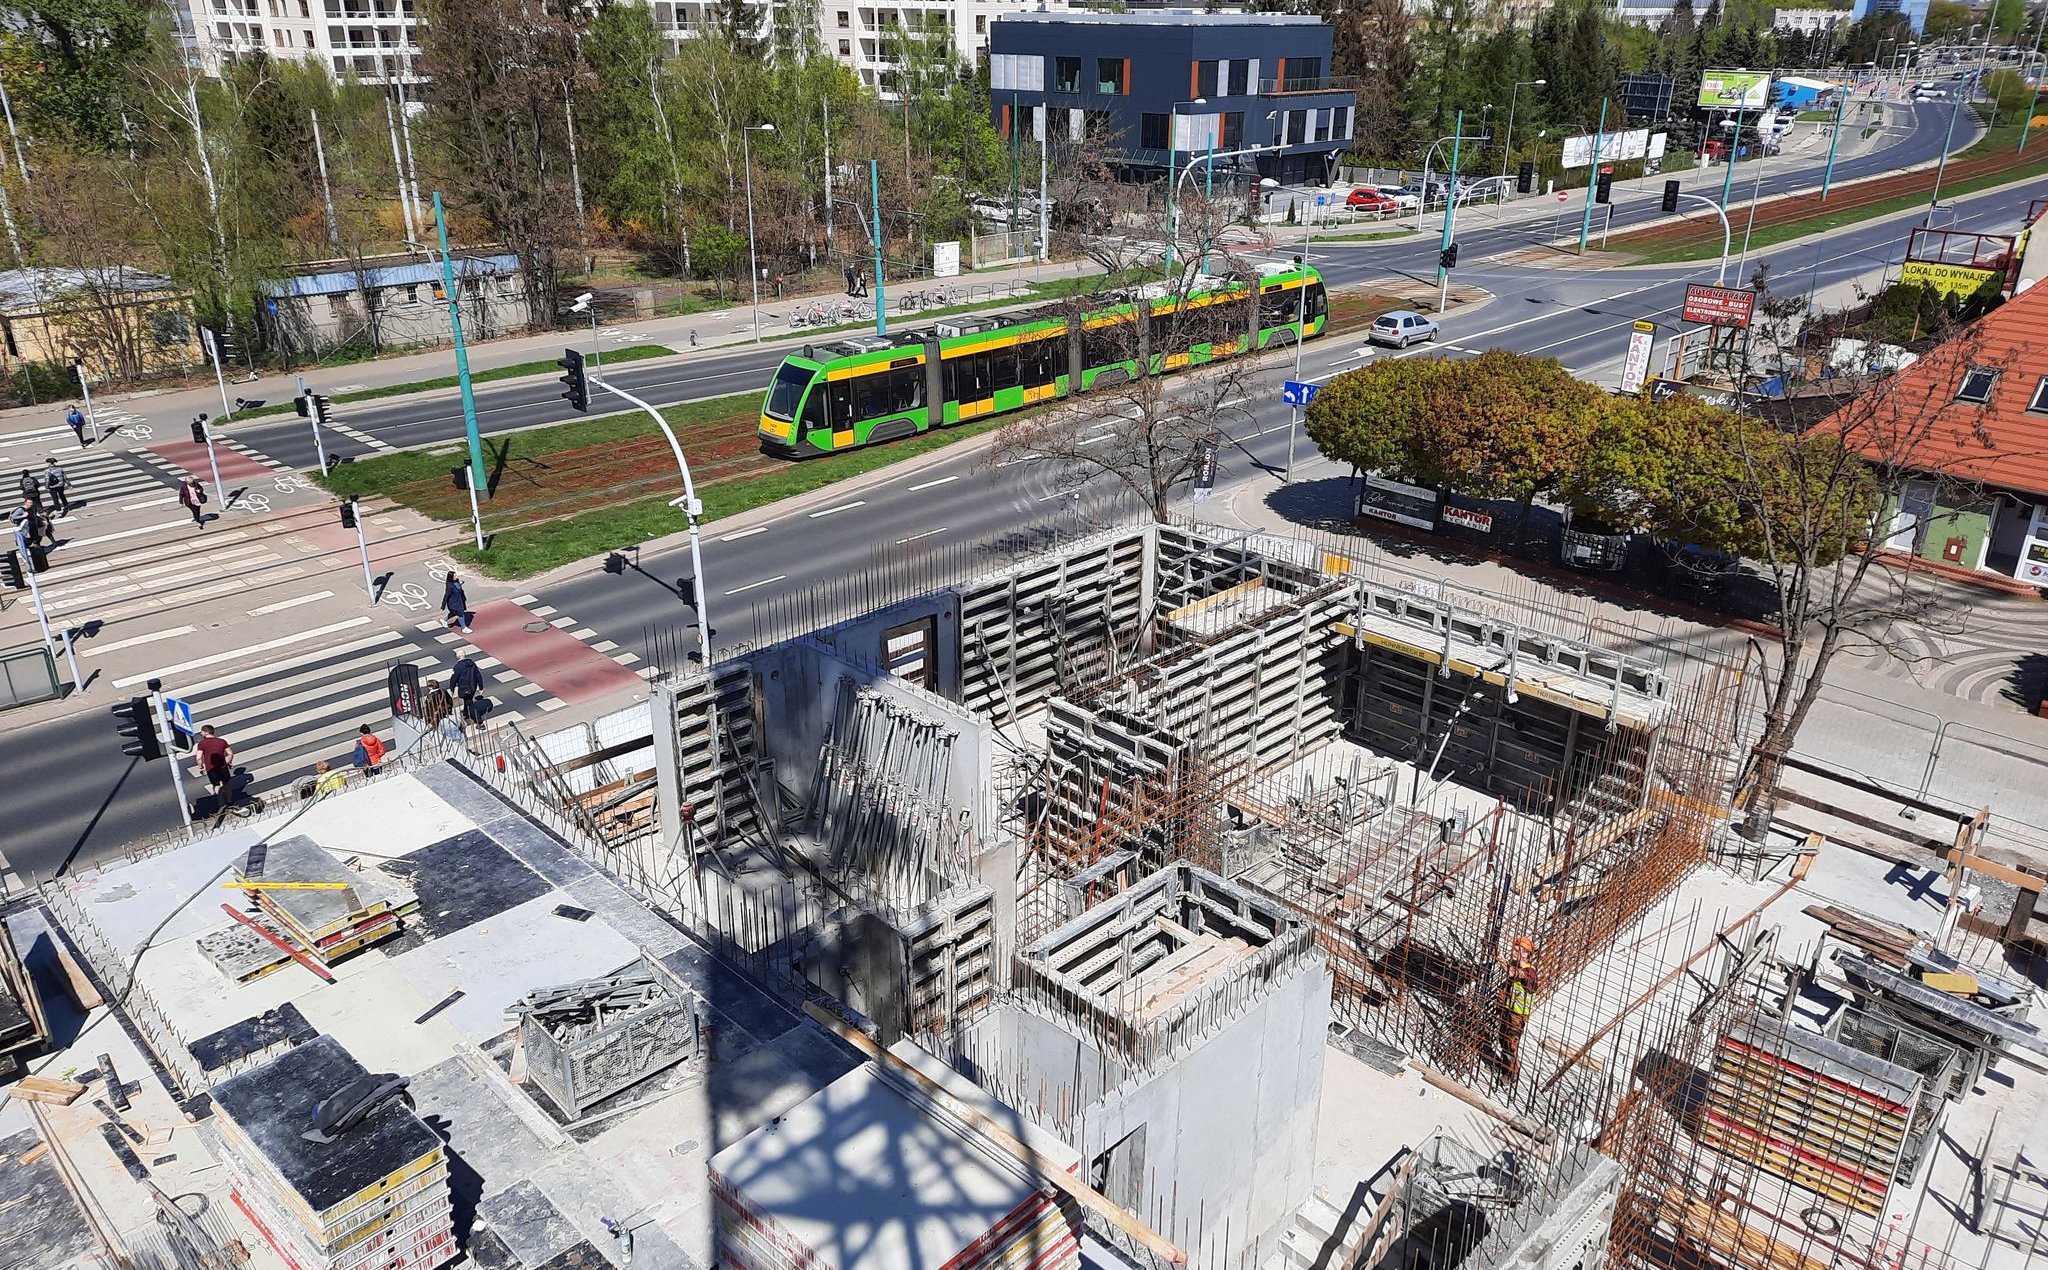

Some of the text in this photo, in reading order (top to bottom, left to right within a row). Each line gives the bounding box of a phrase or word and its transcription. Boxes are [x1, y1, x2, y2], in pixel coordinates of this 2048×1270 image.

[1905, 265, 1933, 277] LOKAL
[1935, 268, 1948, 278] DO
[1688, 295, 1724, 306] OSOBOWE
[1728, 300, 1749, 309] BUSY
[1623, 334, 1643, 390] KANTOR
[1368, 508, 1397, 520] KANTOR
[1444, 506, 1490, 526] KANTOR
